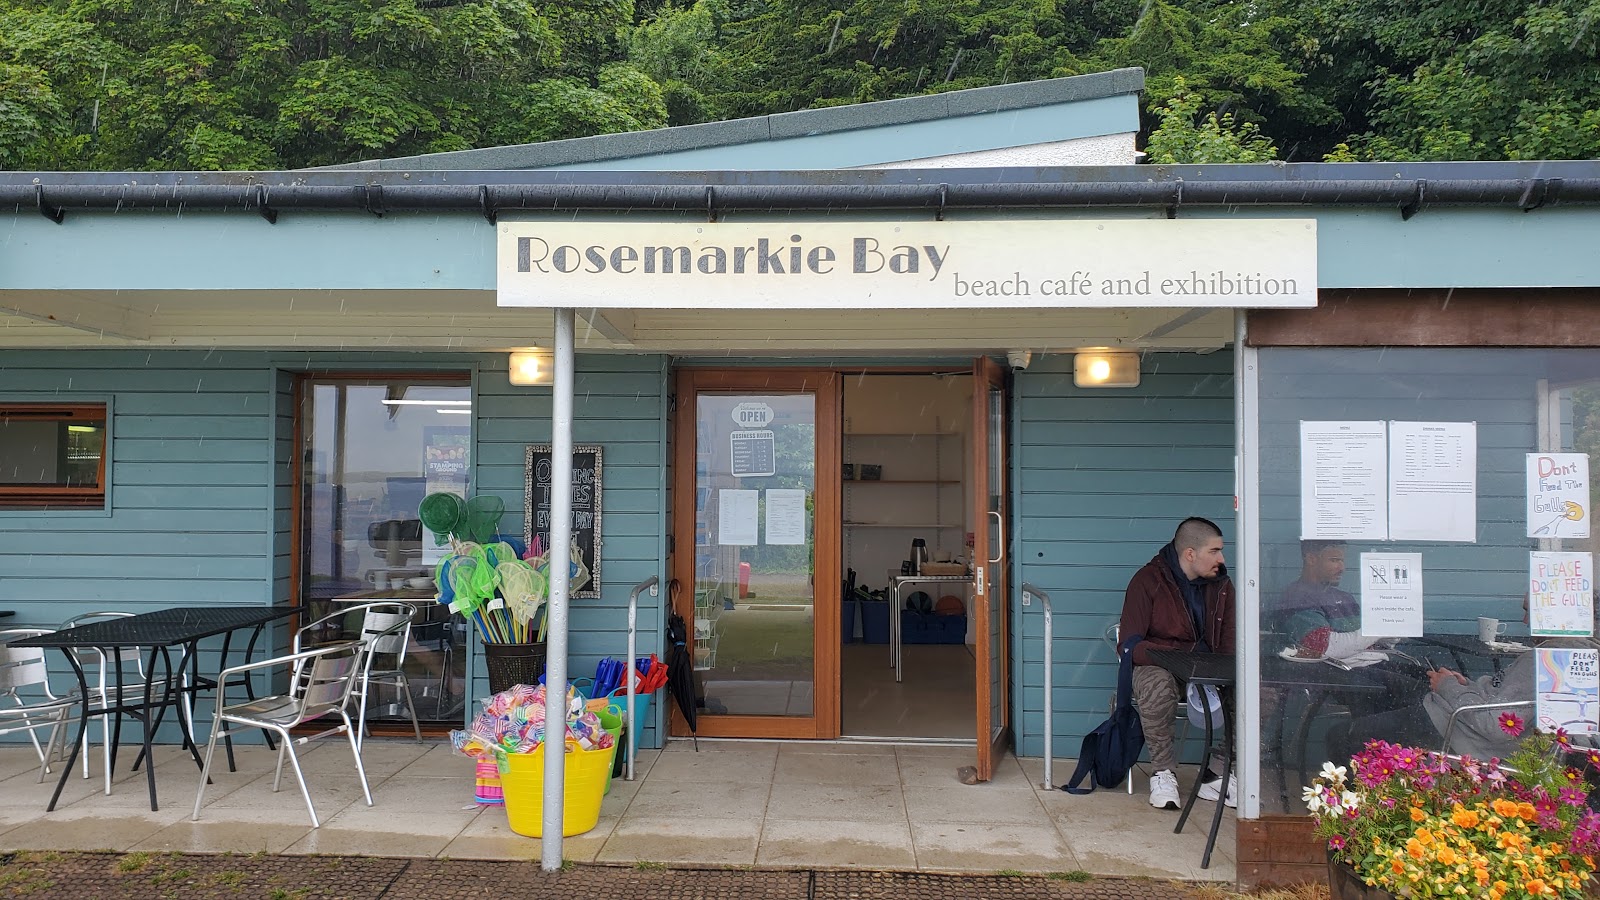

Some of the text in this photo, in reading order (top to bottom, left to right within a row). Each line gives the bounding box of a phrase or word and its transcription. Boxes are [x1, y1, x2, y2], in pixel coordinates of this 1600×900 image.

[517, 234, 950, 282] Rosemarkie Bay
[953, 270, 1299, 297] beach café and exhibition
[739, 410, 766, 423] OPEN
[536, 458, 595, 484] OING
[1565, 480, 1583, 490] The
[575, 511, 594, 529] DAY
[1538, 560, 1583, 578] PLEASE
[1564, 577, 1590, 592] FEED
[1532, 591, 1557, 608] THE
